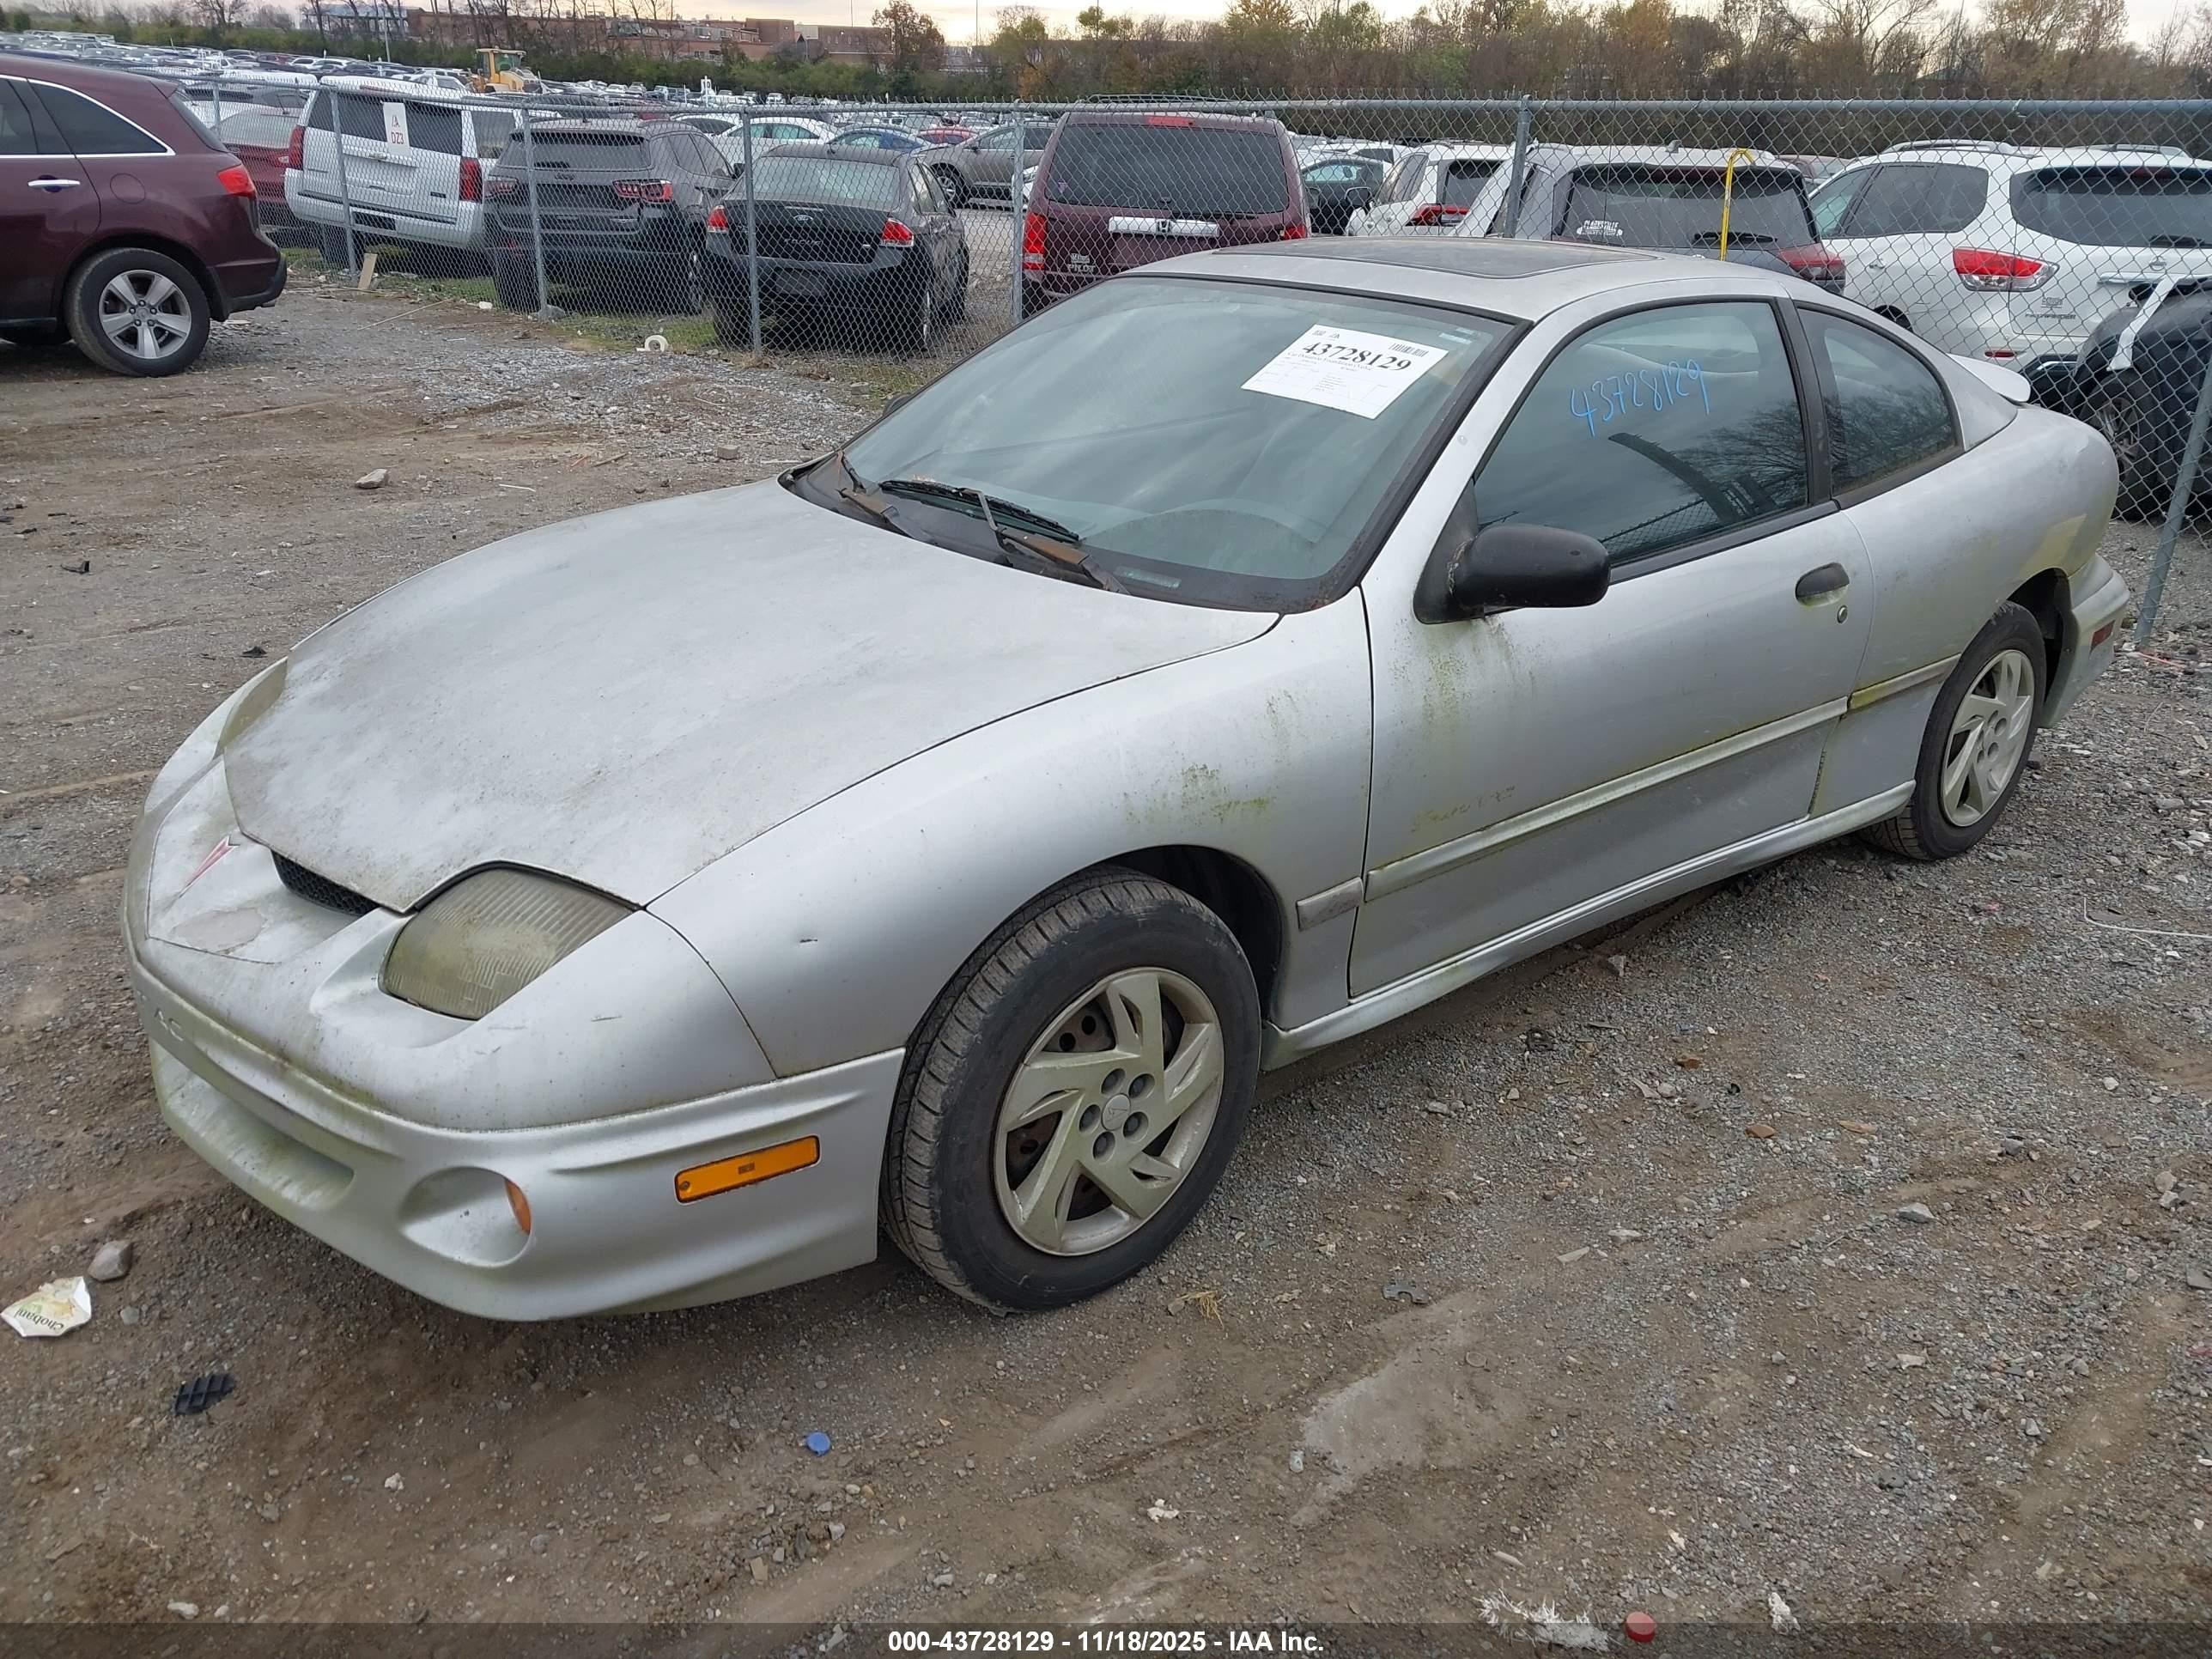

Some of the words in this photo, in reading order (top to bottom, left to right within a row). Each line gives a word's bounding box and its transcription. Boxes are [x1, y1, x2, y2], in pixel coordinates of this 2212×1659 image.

[391, 131, 404, 145] DZ3
[1067, 264, 1096, 272] PILOT
[1304, 342, 1411, 370] 43728129
[1571, 358, 1711, 437] 43728129
